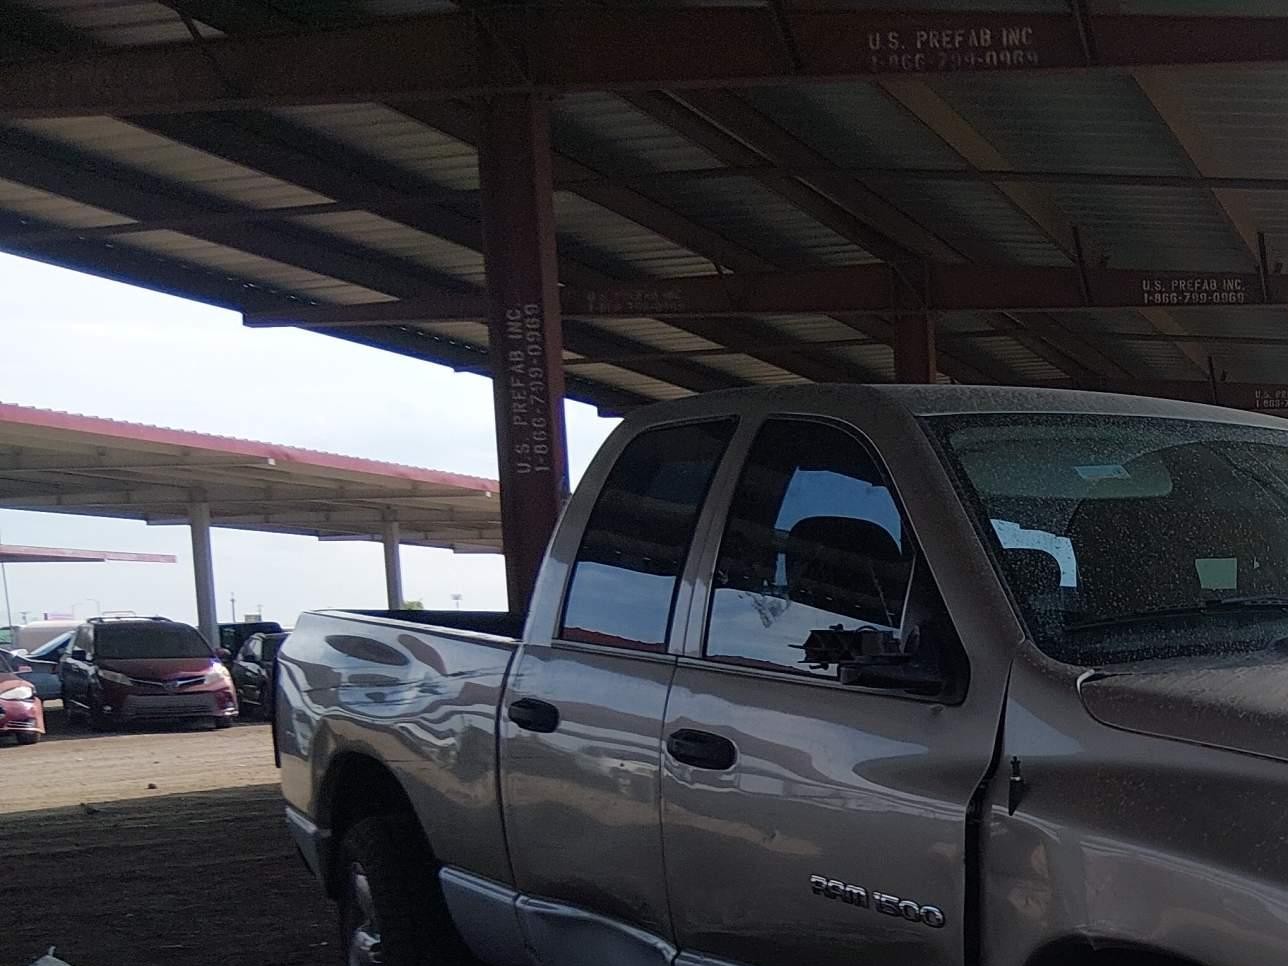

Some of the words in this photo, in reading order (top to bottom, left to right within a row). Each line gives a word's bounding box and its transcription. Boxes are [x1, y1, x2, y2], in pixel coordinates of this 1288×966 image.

[916, 28, 992, 49] PREFAB
[1142, 279, 1166, 292] U.S.
[1171, 279, 1218, 291] PREFAB
[1143, 292, 1245, 305] 1-866-799-0969
[508, 350, 529, 427] PREFAB
[871, 890, 946, 929] 1500
